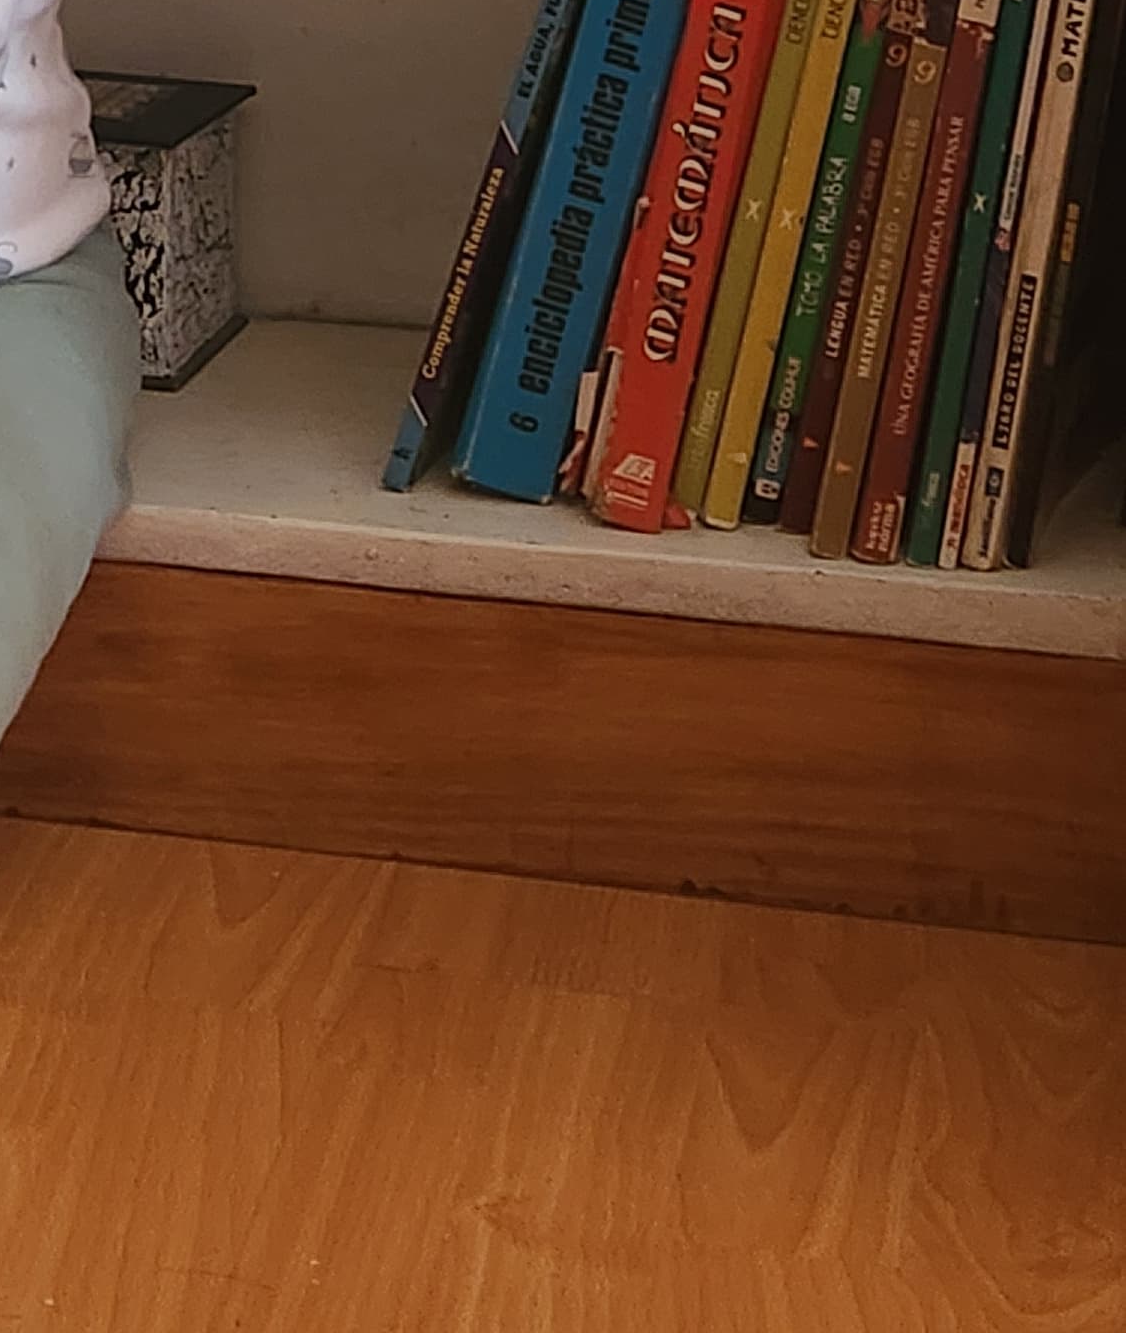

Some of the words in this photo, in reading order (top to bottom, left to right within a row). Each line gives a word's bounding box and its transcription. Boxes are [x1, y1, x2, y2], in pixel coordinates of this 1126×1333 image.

[525, 22, 556, 78] AGUA,
[885, 43, 907, 69] 9
[516, 80, 535, 99] EL
[913, 59, 937, 85] 9
[941, 116, 964, 174] PENSAR
[462, 167, 504, 257] Naturaleza
[814, 156, 848, 234] PALABRA
[932, 177, 953, 216] PARA
[811, 242, 829, 264] LA
[843, 238, 862, 271] RED
[881, 221, 901, 254] RED
[921, 220, 946, 288] AMÉRICA
[455, 258, 474, 276] la
[518, 204, 595, 395] enciclopedia
[837, 274, 855, 298] EN
[916, 291, 931, 311] DE
[421, 275, 467, 379] Comprender
[825, 301, 849, 358] LENGUA
[1011, 281, 1034, 354] DOCENTE
[900, 315, 928, 400] GEOGRAFÍA
[1006, 361, 1021, 388] DEL
[508, 411, 539, 433] 6
[890, 404, 911, 435] UNA
[996, 392, 1015, 444] LIBRO
